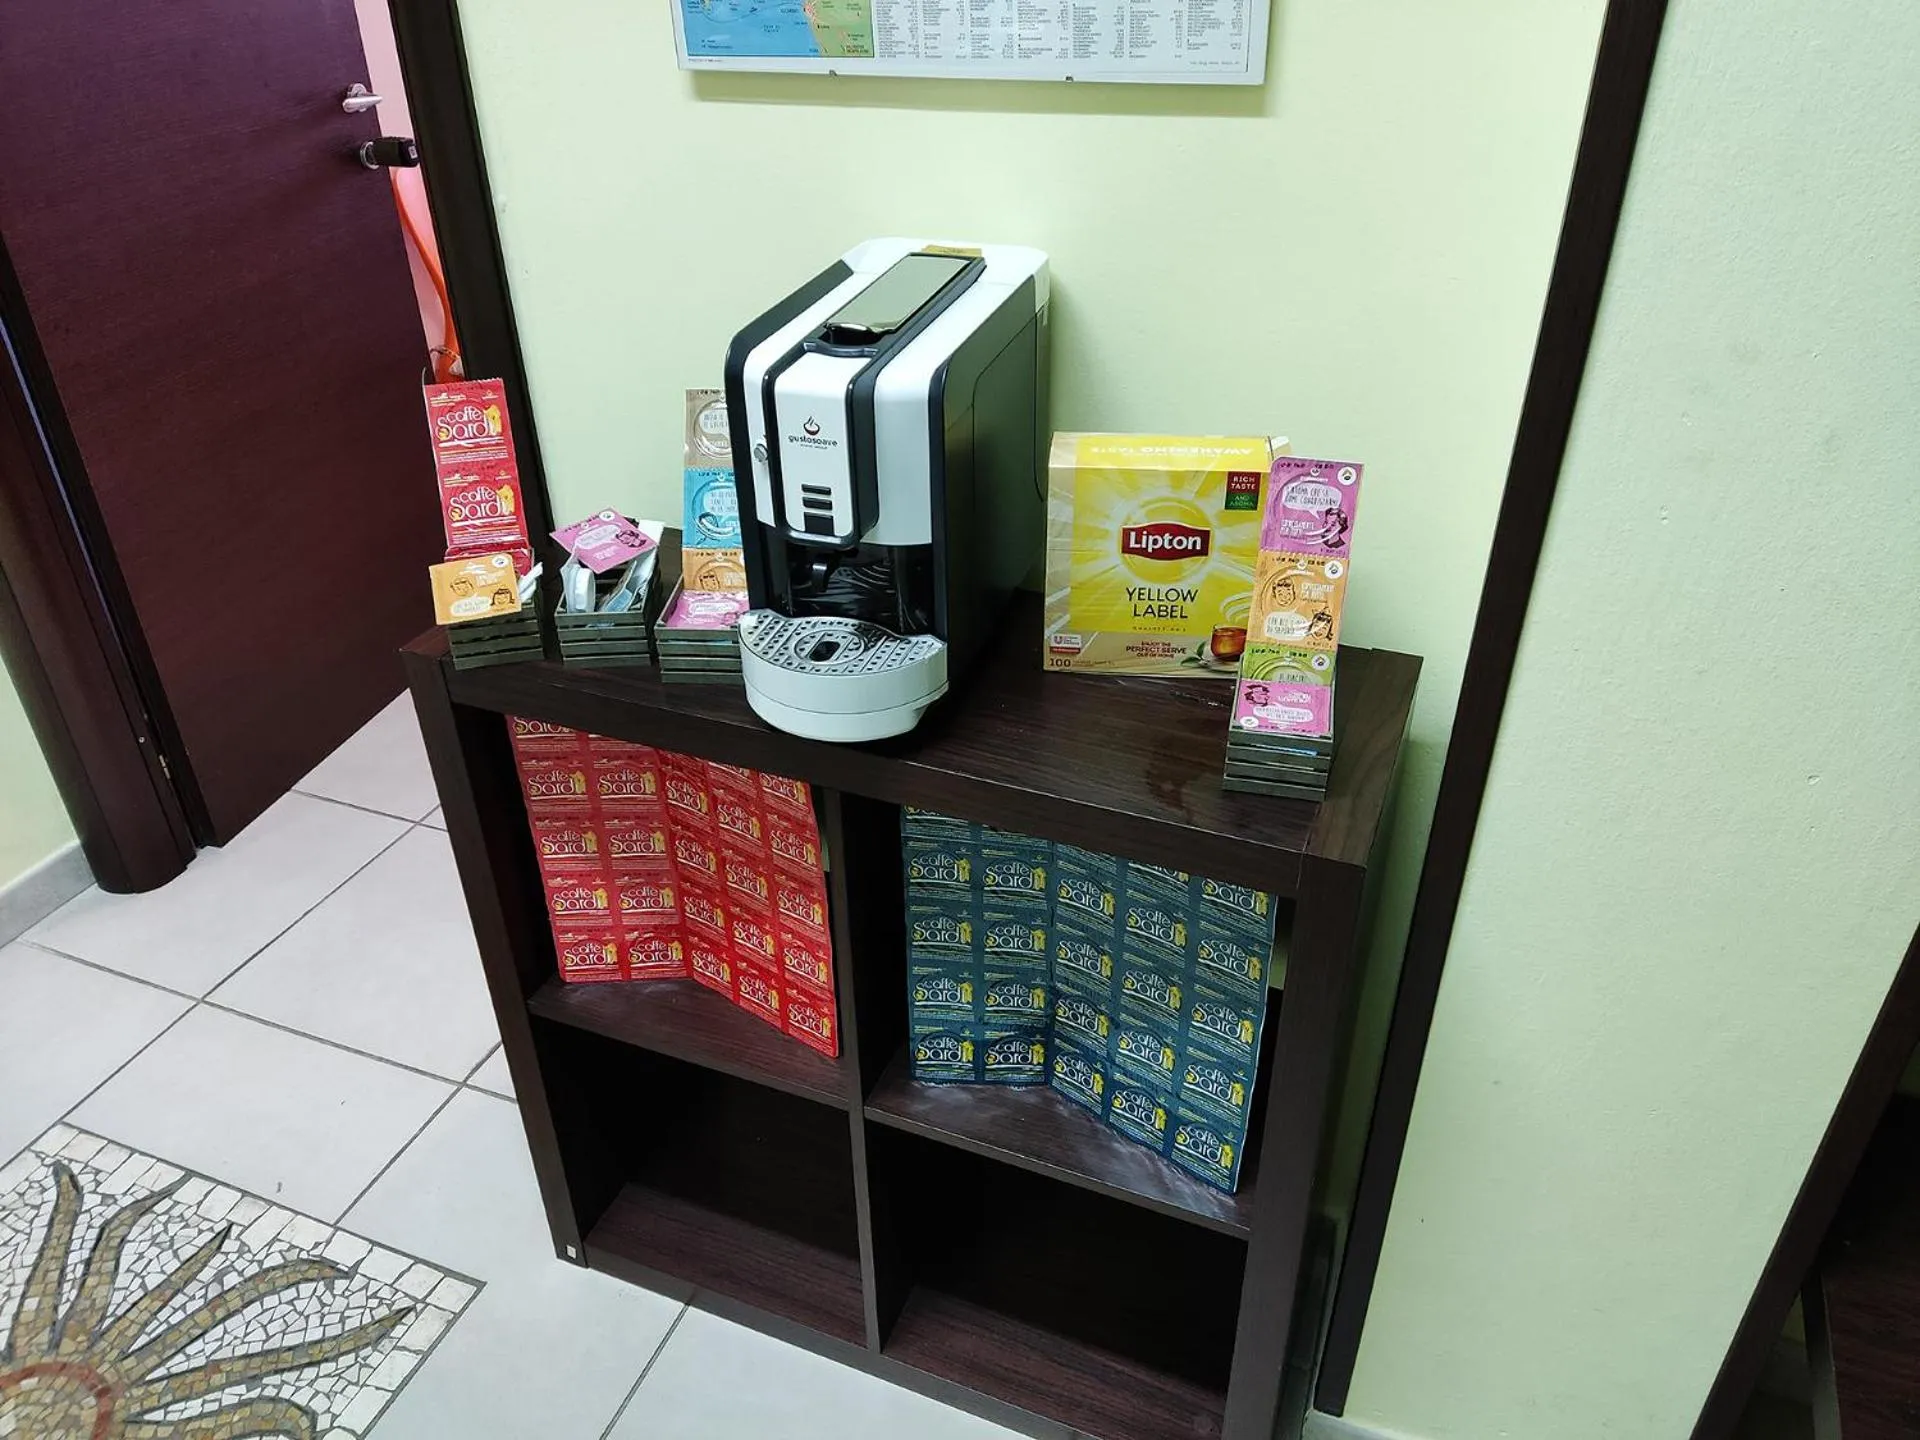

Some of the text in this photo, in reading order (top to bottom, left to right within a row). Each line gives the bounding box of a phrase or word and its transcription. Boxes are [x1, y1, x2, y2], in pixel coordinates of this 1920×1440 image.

[1129, 531, 1201, 553] Lipton
[1126, 587, 1198, 602] YELLOW
[1133, 604, 1188, 619] LABEL
[1050, 658, 1071, 668] 100
